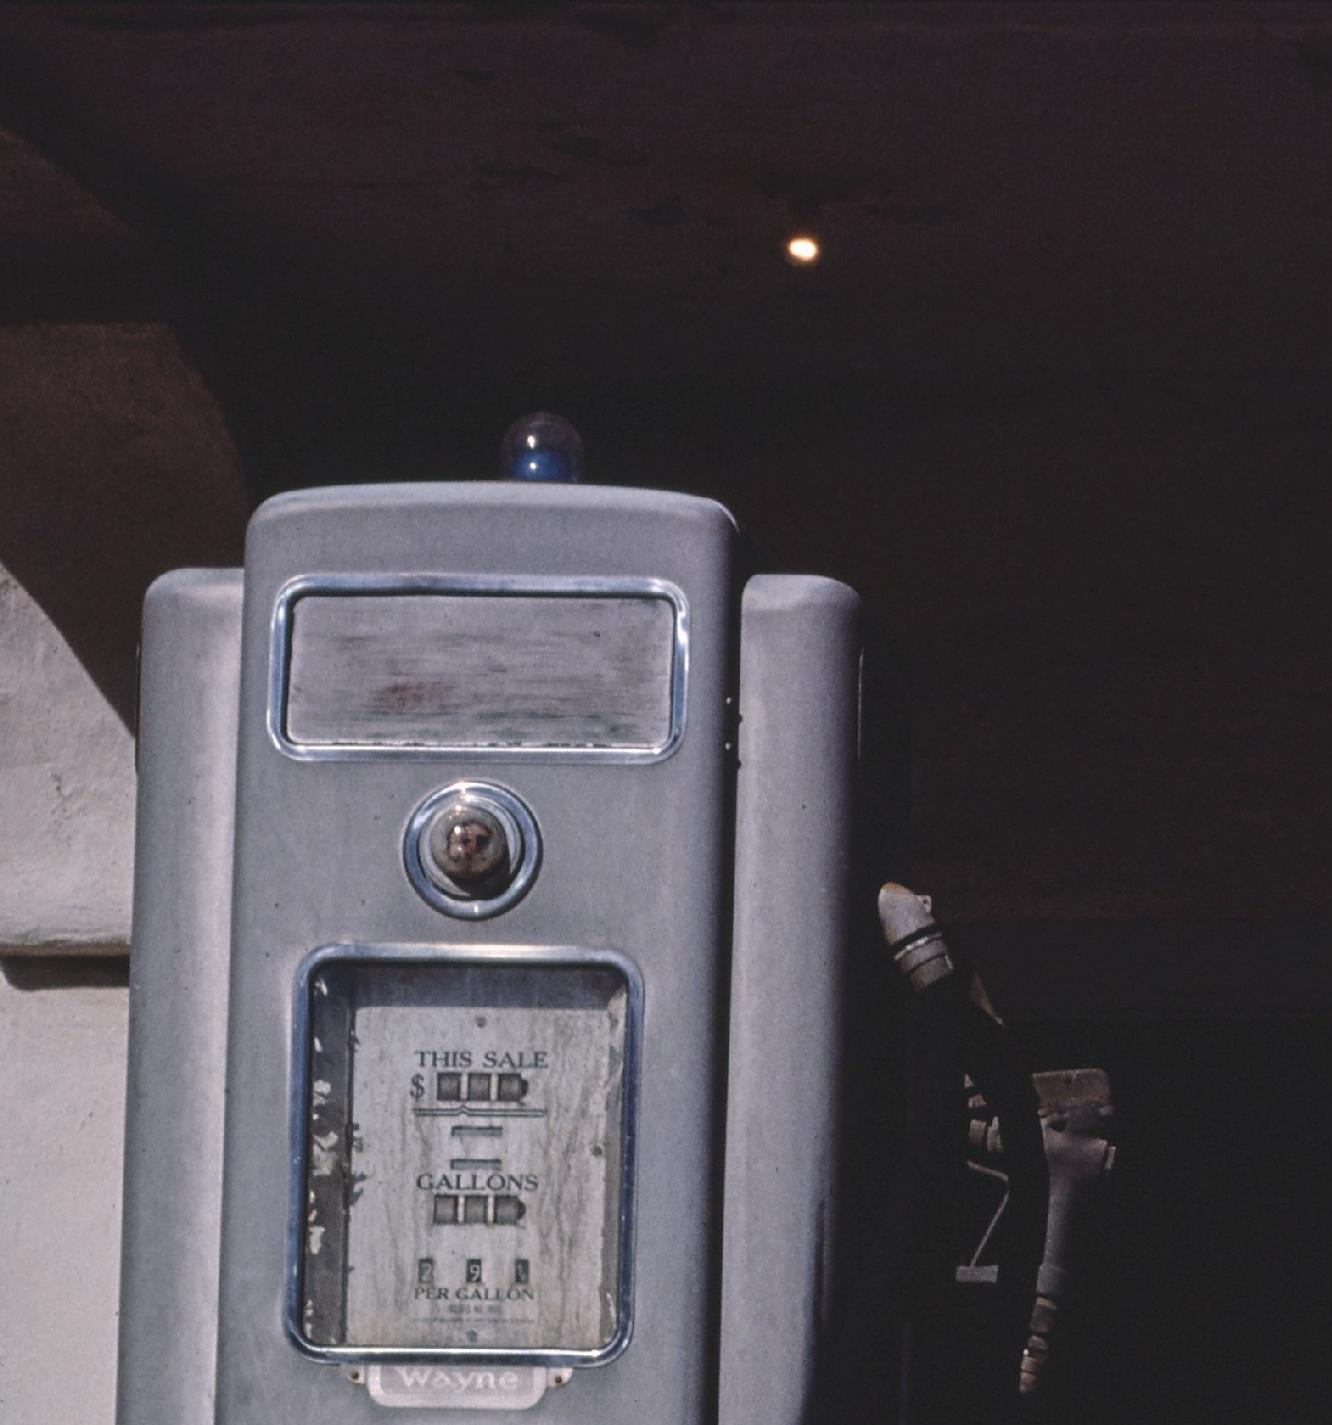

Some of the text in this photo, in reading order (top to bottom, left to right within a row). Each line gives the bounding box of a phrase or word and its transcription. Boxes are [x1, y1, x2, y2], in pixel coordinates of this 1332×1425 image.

[415, 1051, 549, 1068] THIS SALE
[410, 1075, 425, 1100] $
[417, 1174, 539, 1191] GALLONS
[414, 1288, 535, 1301] PER GALLON
